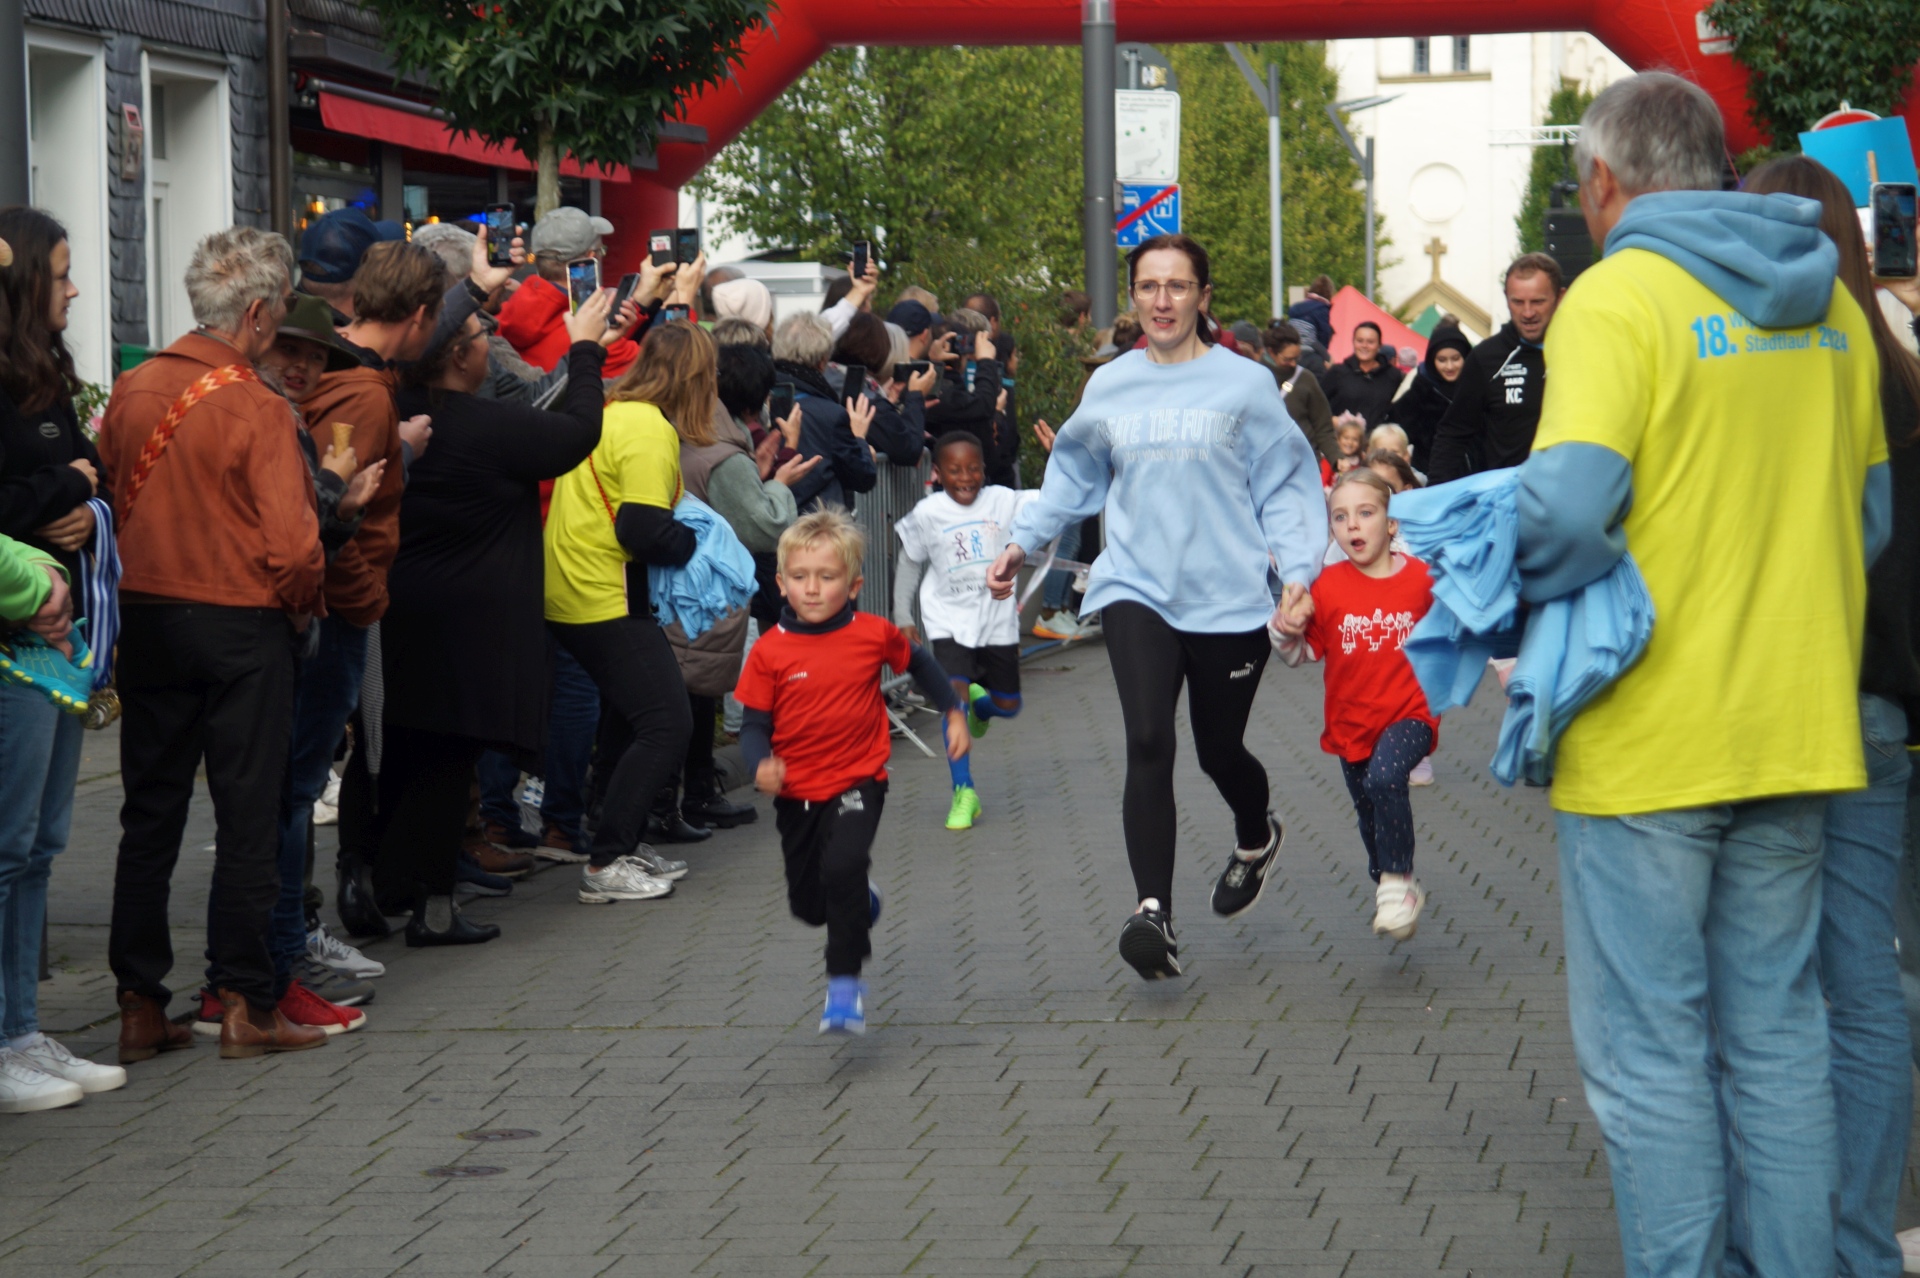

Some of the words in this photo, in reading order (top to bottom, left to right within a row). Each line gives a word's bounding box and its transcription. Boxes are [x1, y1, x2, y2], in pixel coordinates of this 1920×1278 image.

[1690, 314, 1738, 359] 18.
[1745, 331, 1811, 352] Stadtlauf
[1505, 387, 1523, 404] KC
[1097, 411, 1143, 448] EATE
[1149, 407, 1180, 442] THE
